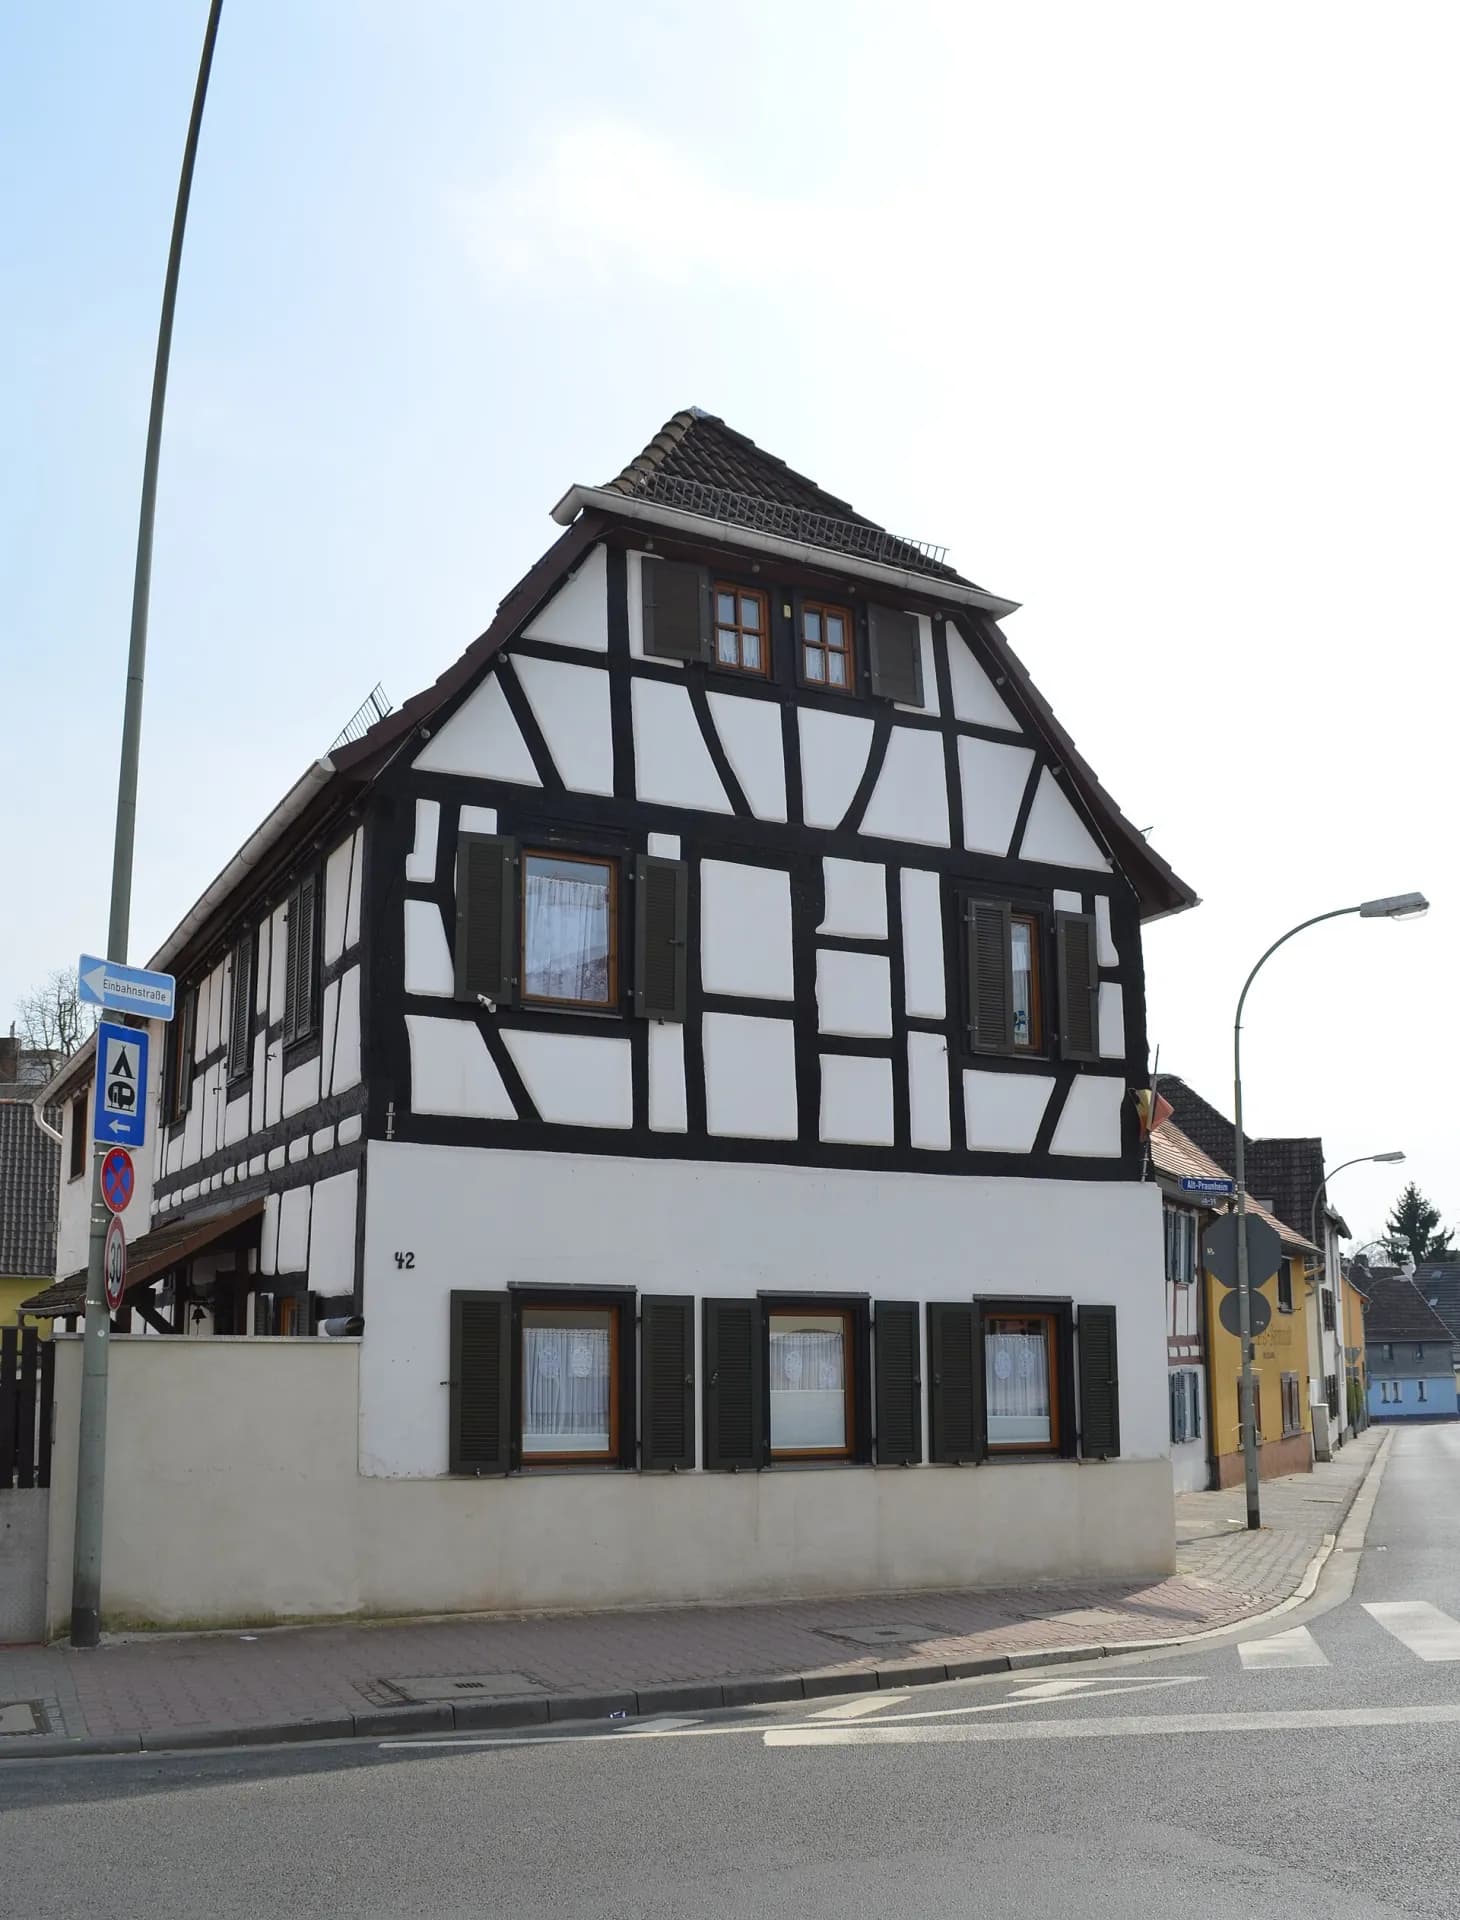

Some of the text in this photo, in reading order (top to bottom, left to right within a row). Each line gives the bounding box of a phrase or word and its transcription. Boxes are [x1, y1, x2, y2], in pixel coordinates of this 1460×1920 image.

[103, 979, 166, 1002] Einbahnstraße
[110, 1242, 122, 1283] 30
[394, 1251, 415, 1270] 42
